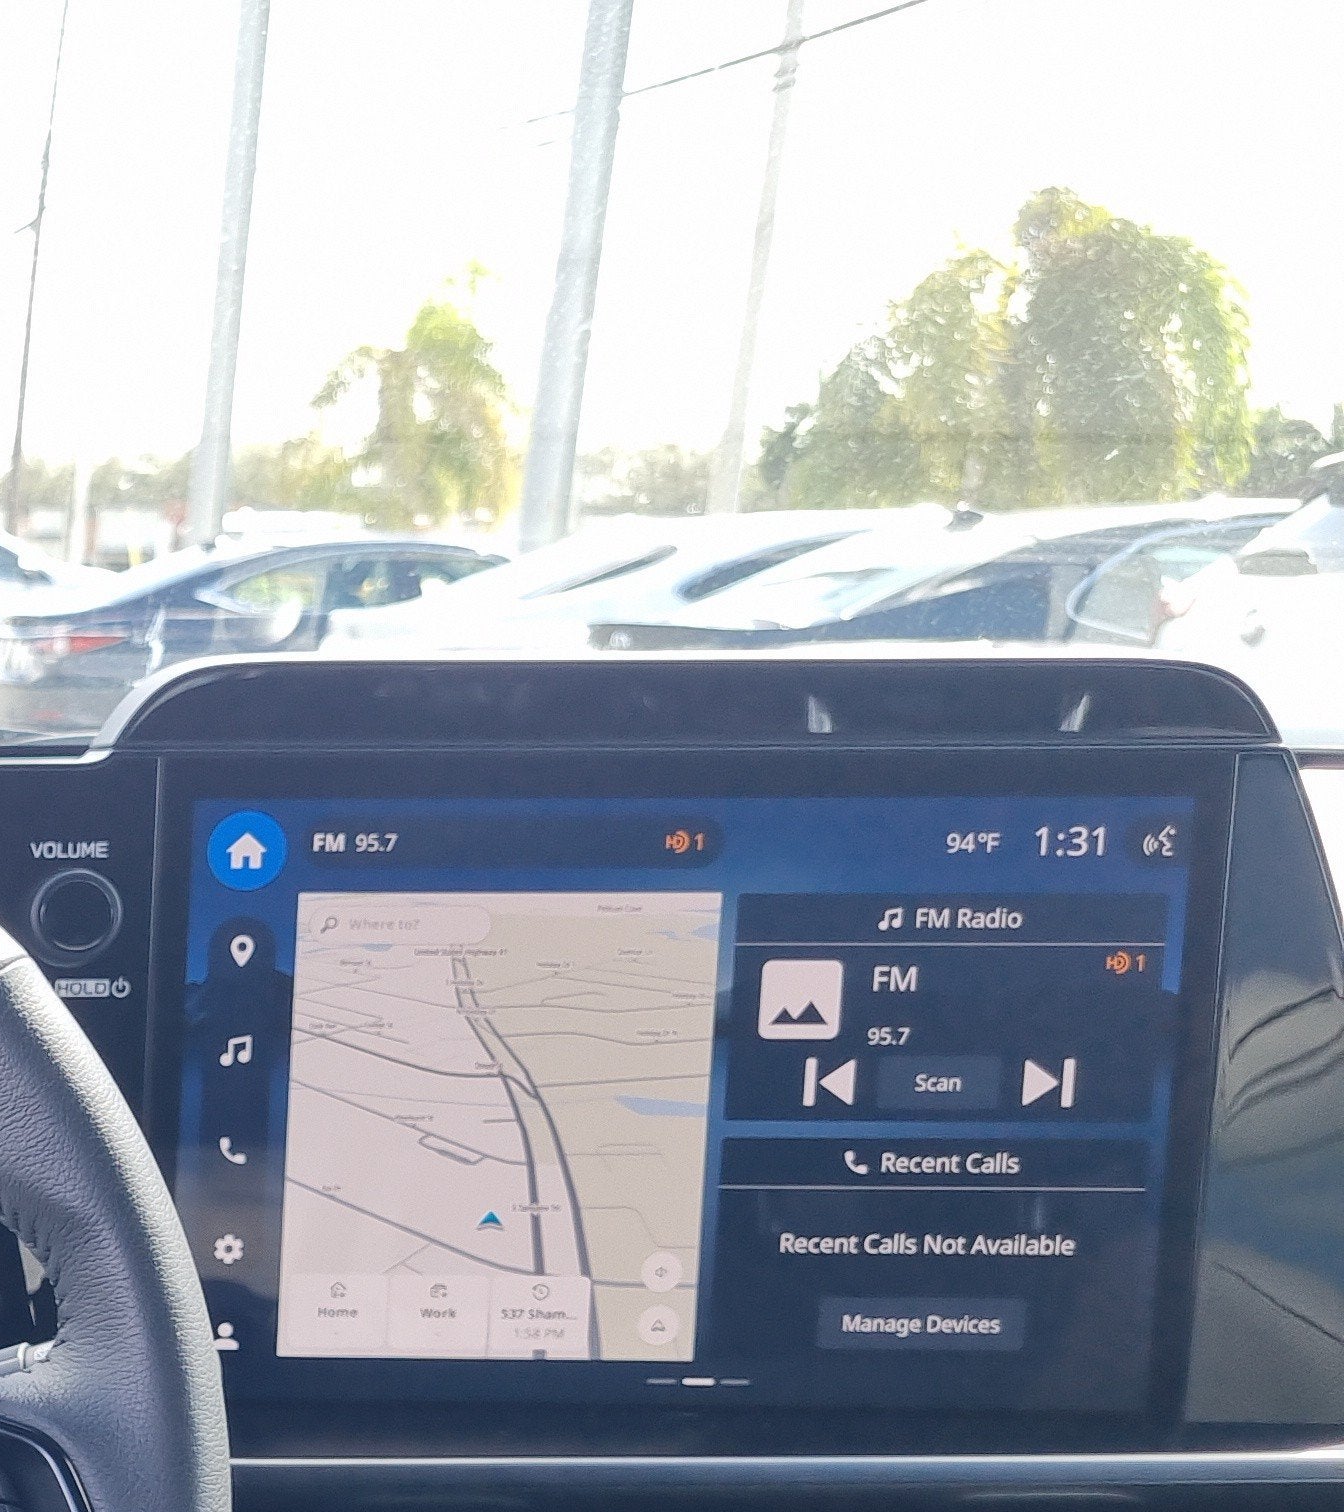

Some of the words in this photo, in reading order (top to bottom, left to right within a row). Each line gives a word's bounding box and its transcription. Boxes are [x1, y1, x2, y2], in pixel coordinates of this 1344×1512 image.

[30, 840, 109, 859] VOLUME
[312, 832, 346, 853] FM
[355, 832, 398, 854] 95.7
[945, 832, 1001, 855] 94°F
[1035, 826, 1108, 857] 1:31
[349, 919, 394, 930] Where
[916, 909, 951, 930] FM
[959, 908, 1023, 930] Radio
[56, 981, 108, 997] HOLD
[873, 966, 918, 993] FM
[867, 1028, 911, 1046] 95.7
[915, 1074, 961, 1092] Scan
[880, 1153, 960, 1174] Recent
[966, 1152, 1020, 1175] Calls
[779, 1233, 858, 1255] Recent
[864, 1233, 917, 1255] Calls
[923, 1234, 966, 1255] Not
[970, 1235, 1075, 1257] Available
[318, 1307, 358, 1318] Home
[420, 1308, 456, 1318] Work
[842, 1315, 921, 1337] Manage
[926, 1315, 1001, 1335] Devices
